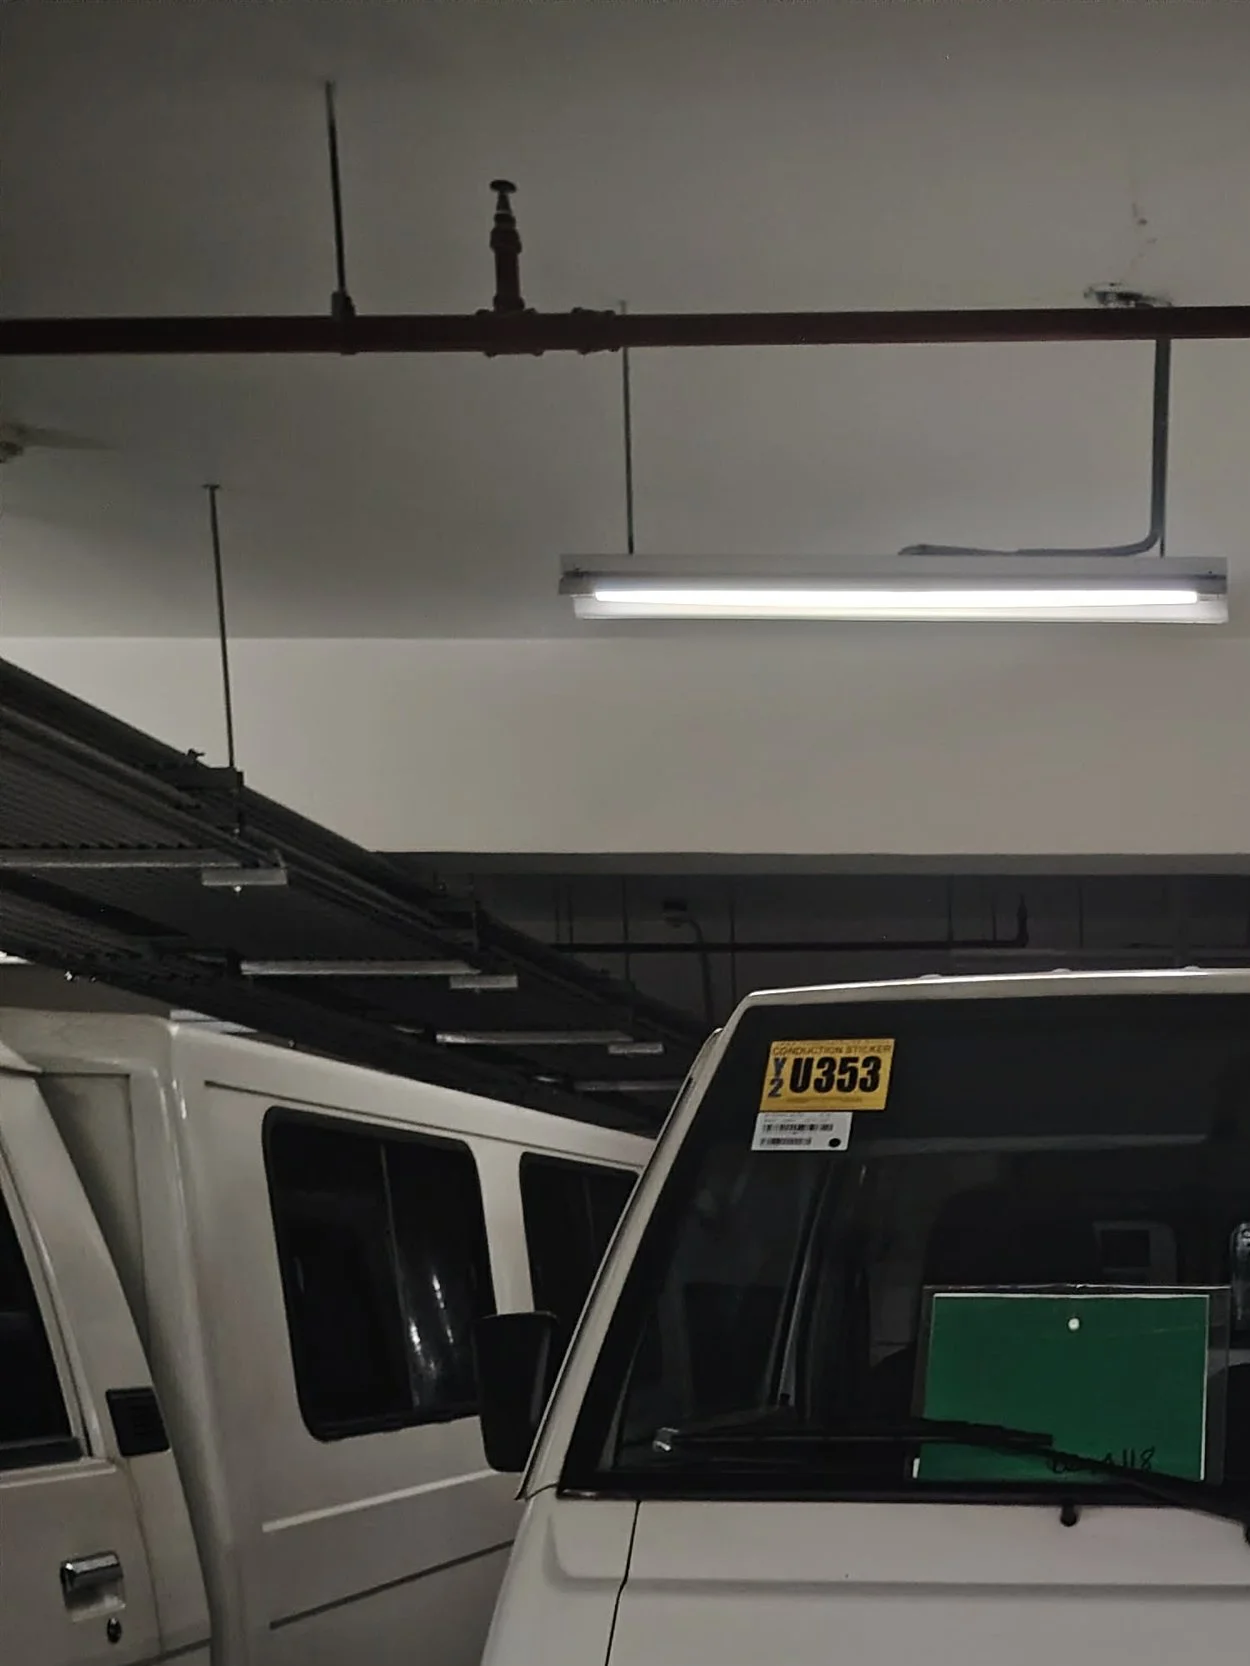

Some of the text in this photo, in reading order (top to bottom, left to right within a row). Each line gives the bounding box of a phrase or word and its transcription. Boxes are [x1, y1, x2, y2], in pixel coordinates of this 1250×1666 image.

[773, 1044, 892, 1056] CONDUCTION STICKER
[789, 1055, 882, 1094] U353
